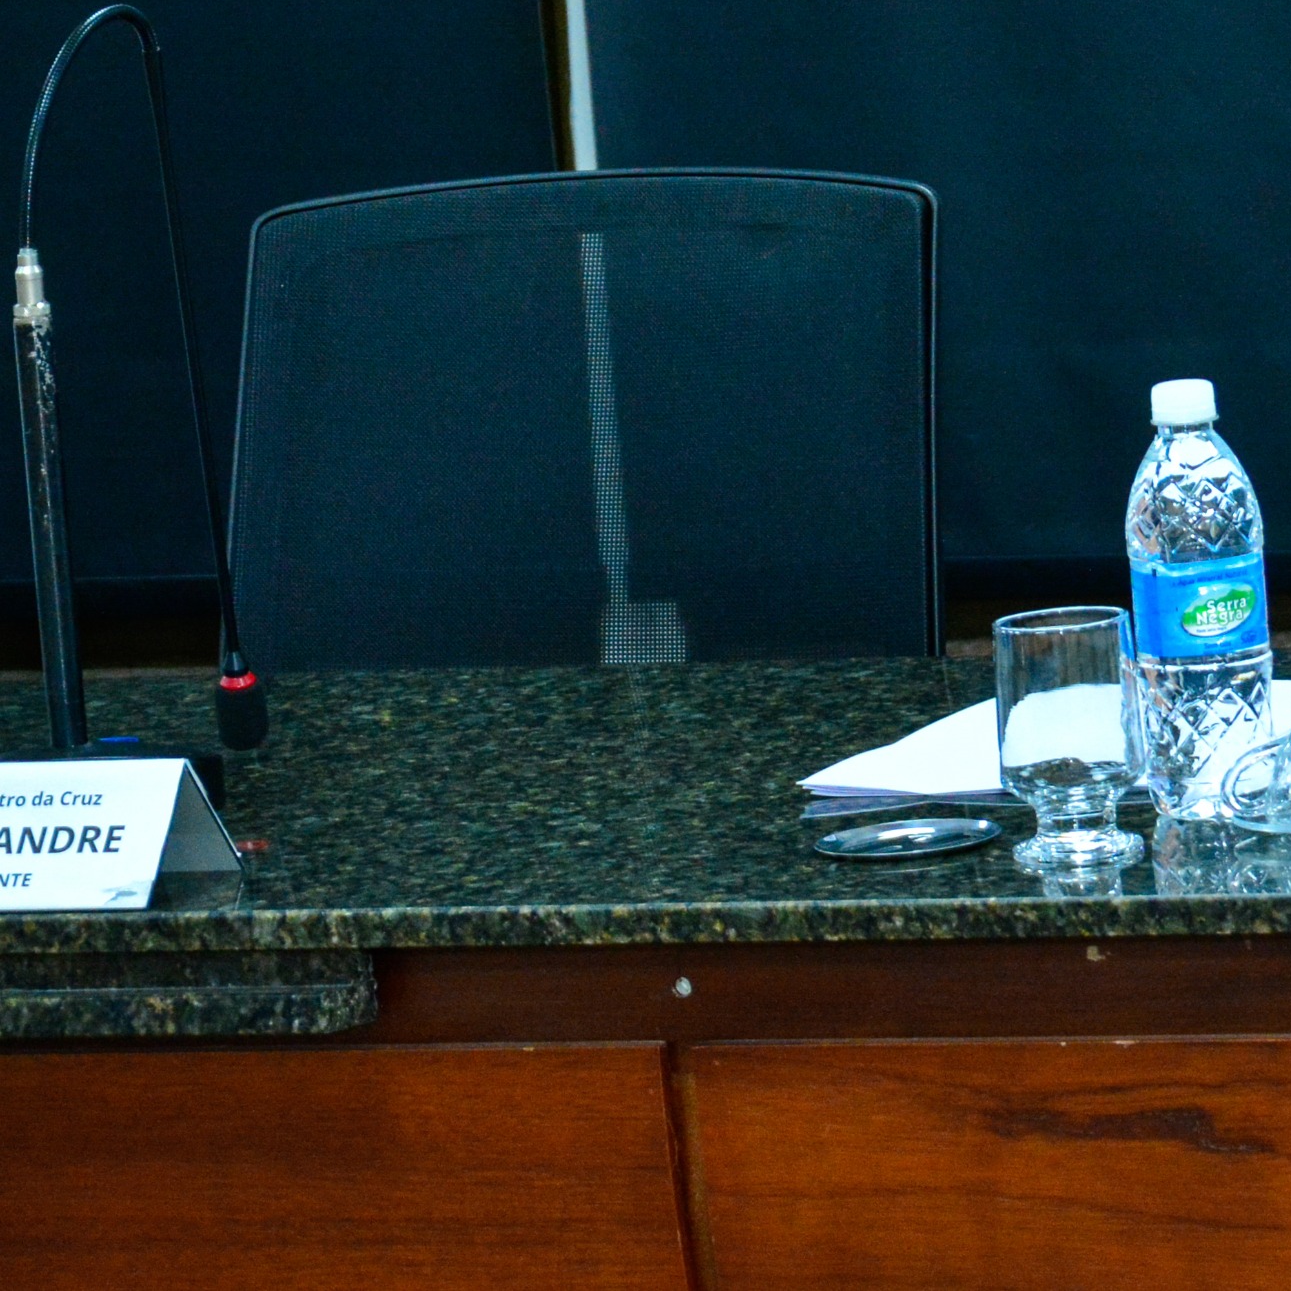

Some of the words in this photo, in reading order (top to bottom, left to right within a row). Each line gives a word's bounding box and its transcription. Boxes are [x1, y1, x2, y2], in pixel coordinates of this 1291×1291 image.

[1206, 597, 1247, 613] Serra
[1196, 609, 1243, 626] Negra
[31, 791, 54, 806] da
[60, 791, 103, 806] Cruz
[0, 825, 125, 854] ANDRE
